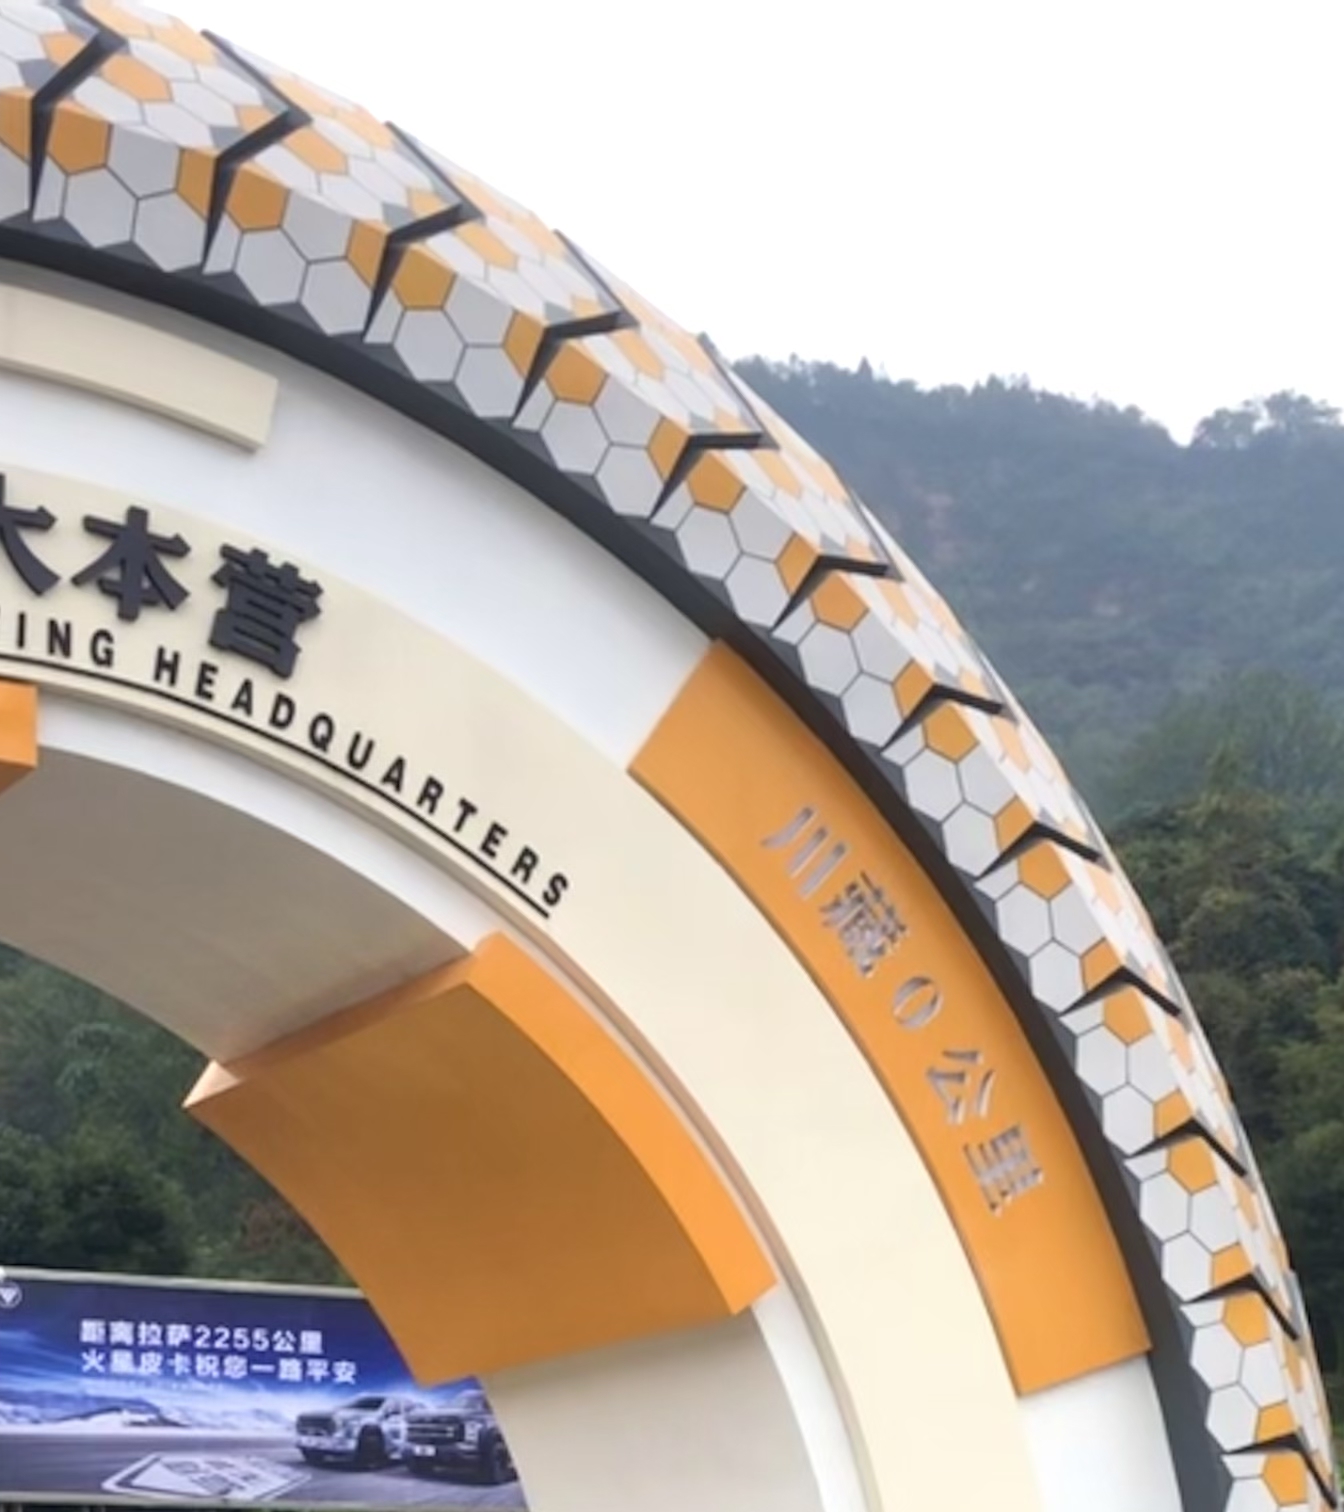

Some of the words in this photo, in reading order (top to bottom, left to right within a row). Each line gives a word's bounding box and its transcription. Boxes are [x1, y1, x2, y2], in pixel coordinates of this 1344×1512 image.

[153, 646, 571, 910] HEADQUARTERS
[80, 1319, 323, 1354] 距离拉萨2255公里
[81, 1350, 356, 1384] 火星皮卡祝您一路平安
